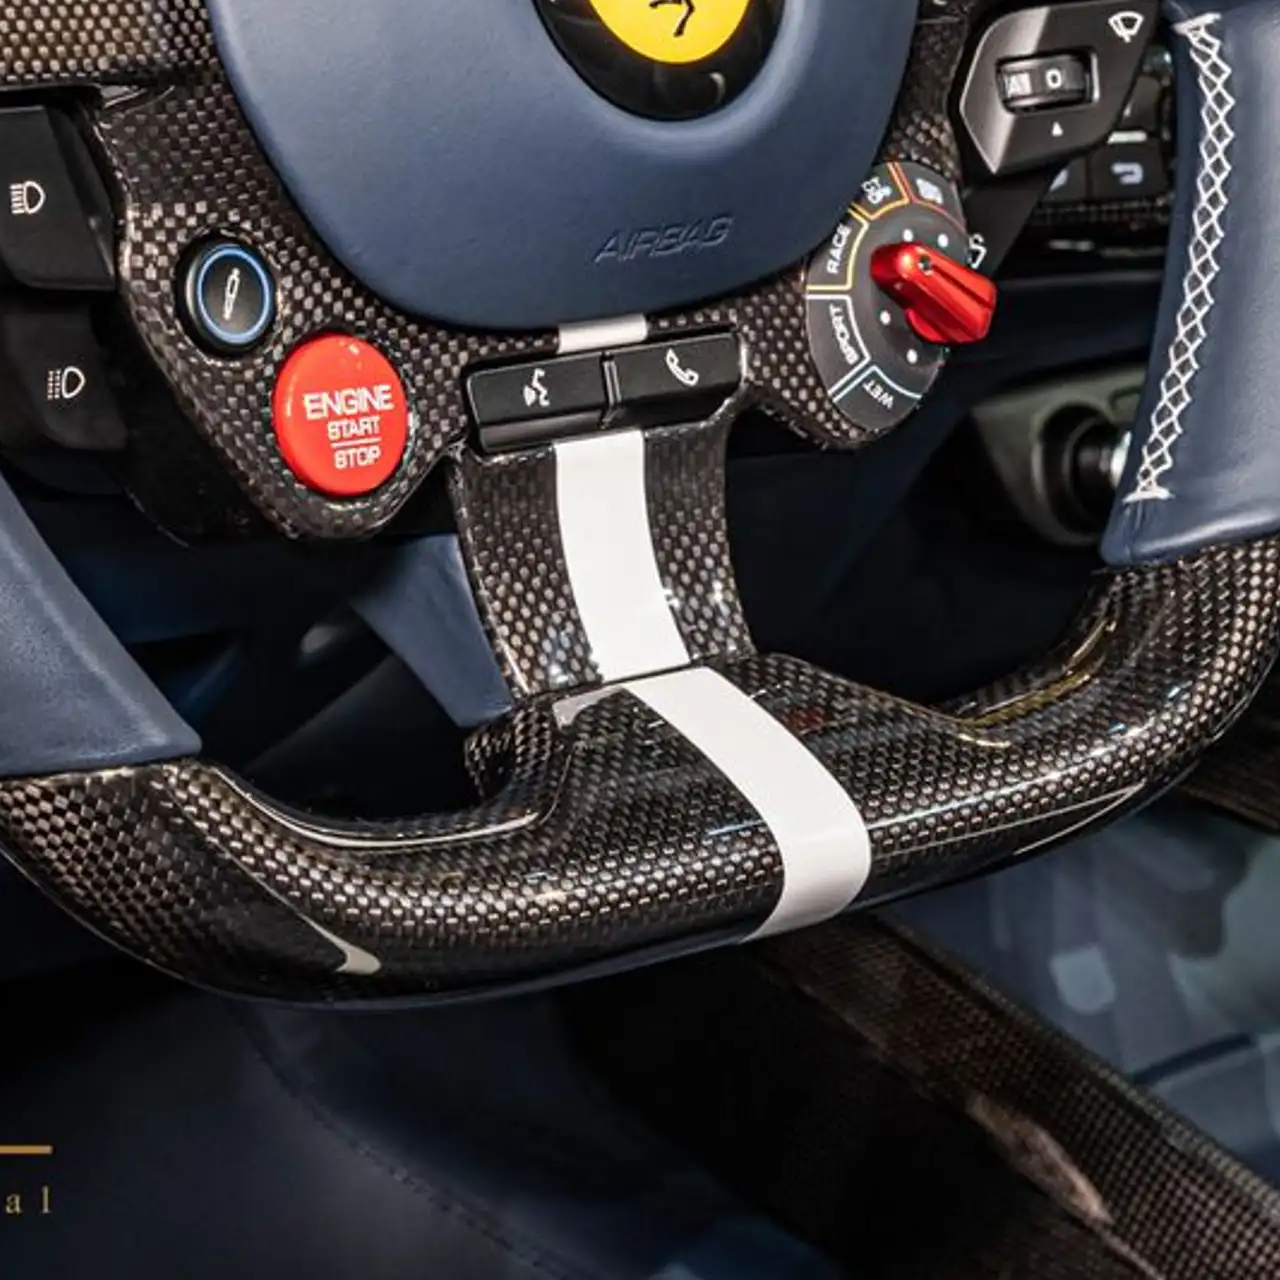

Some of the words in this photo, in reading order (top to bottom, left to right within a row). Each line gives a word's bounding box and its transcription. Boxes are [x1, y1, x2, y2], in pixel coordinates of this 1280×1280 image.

[592, 215, 735, 264] AIRBAG
[826, 222, 853, 276] RACE
[303, 384, 396, 421] ENGINE
[862, 379, 895, 410] WET
[327, 415, 381, 441] START
[334, 445, 382, 470] STOP
